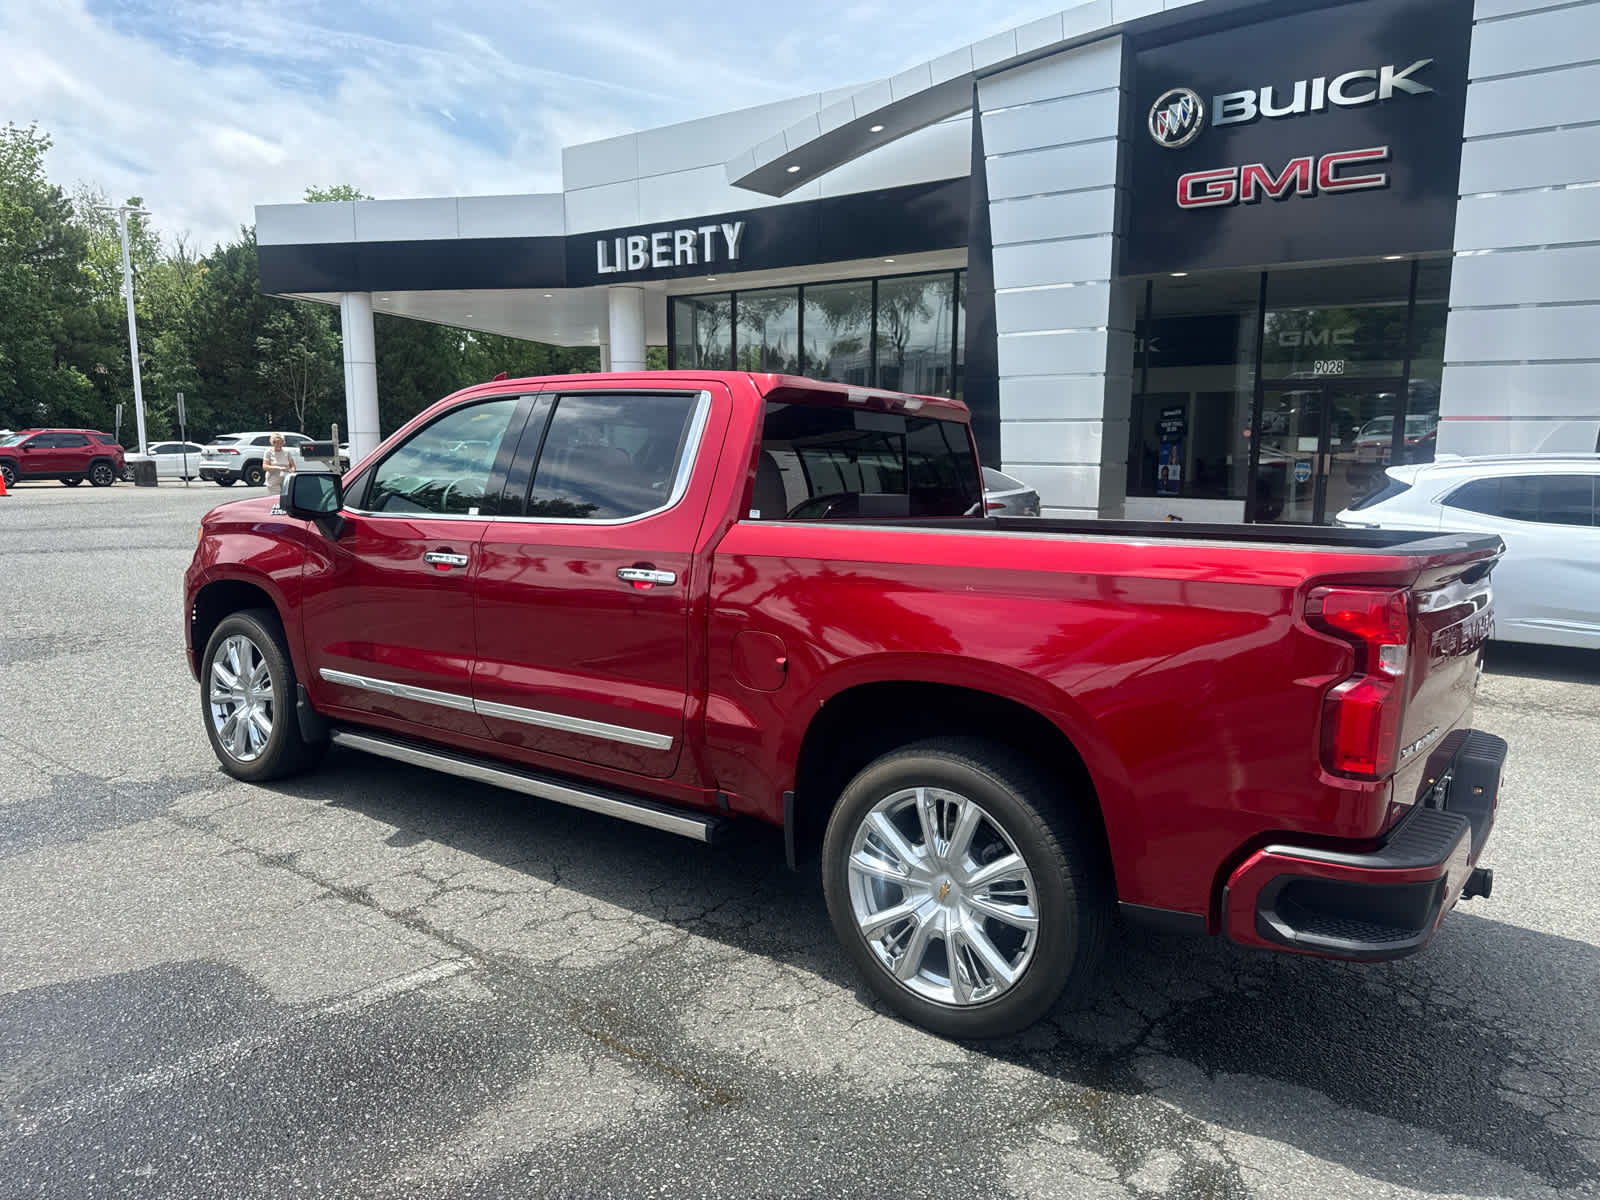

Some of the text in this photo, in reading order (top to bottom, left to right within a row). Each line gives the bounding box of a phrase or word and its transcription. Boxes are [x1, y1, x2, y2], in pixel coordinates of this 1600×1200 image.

[1211, 58, 1434, 126] BUICK
[1176, 146, 1389, 208] GMC
[597, 221, 745, 274] LIBERTY
[1279, 328, 1355, 346] GMC
[1314, 360, 1344, 375] 9028
